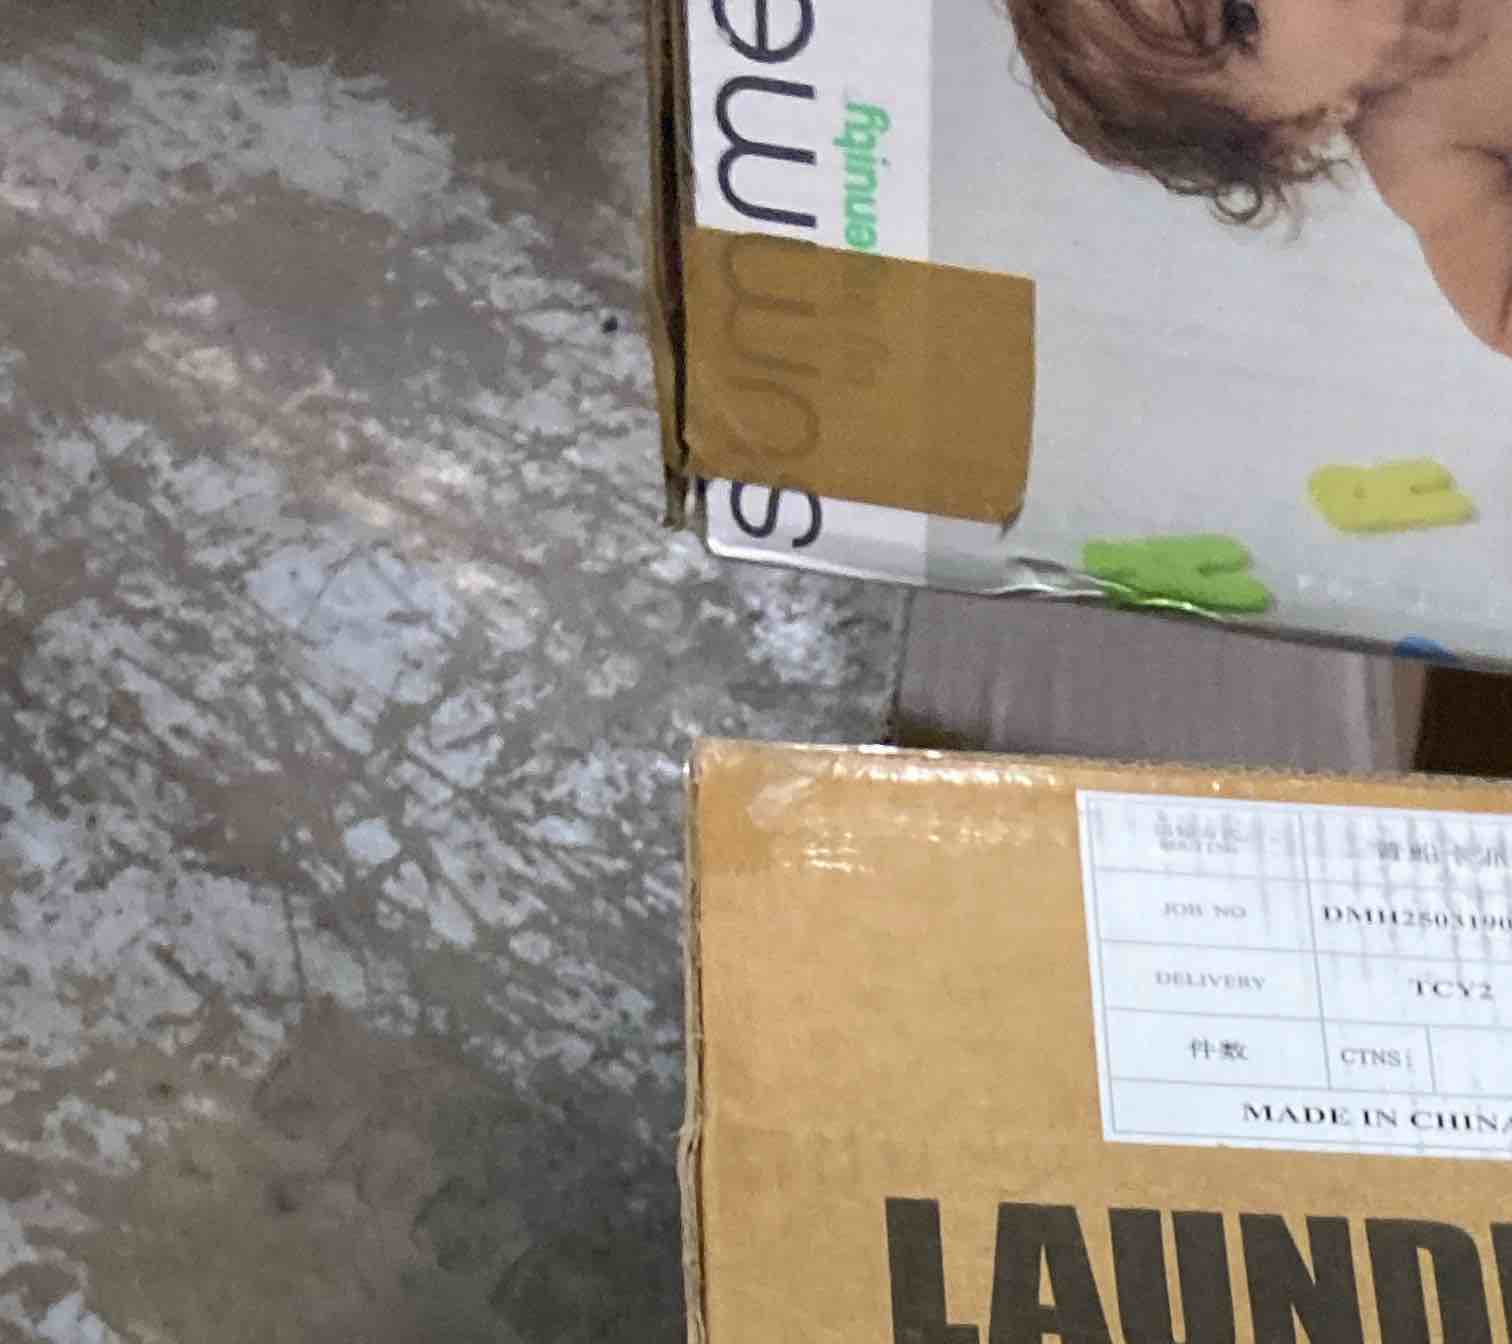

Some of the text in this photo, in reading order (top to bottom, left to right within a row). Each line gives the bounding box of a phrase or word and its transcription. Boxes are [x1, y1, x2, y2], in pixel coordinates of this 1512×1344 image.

[1154, 970, 1267, 991] DELIVERY
[1241, 1101, 1355, 1128] MADE
[1362, 1107, 1399, 1129] IN
